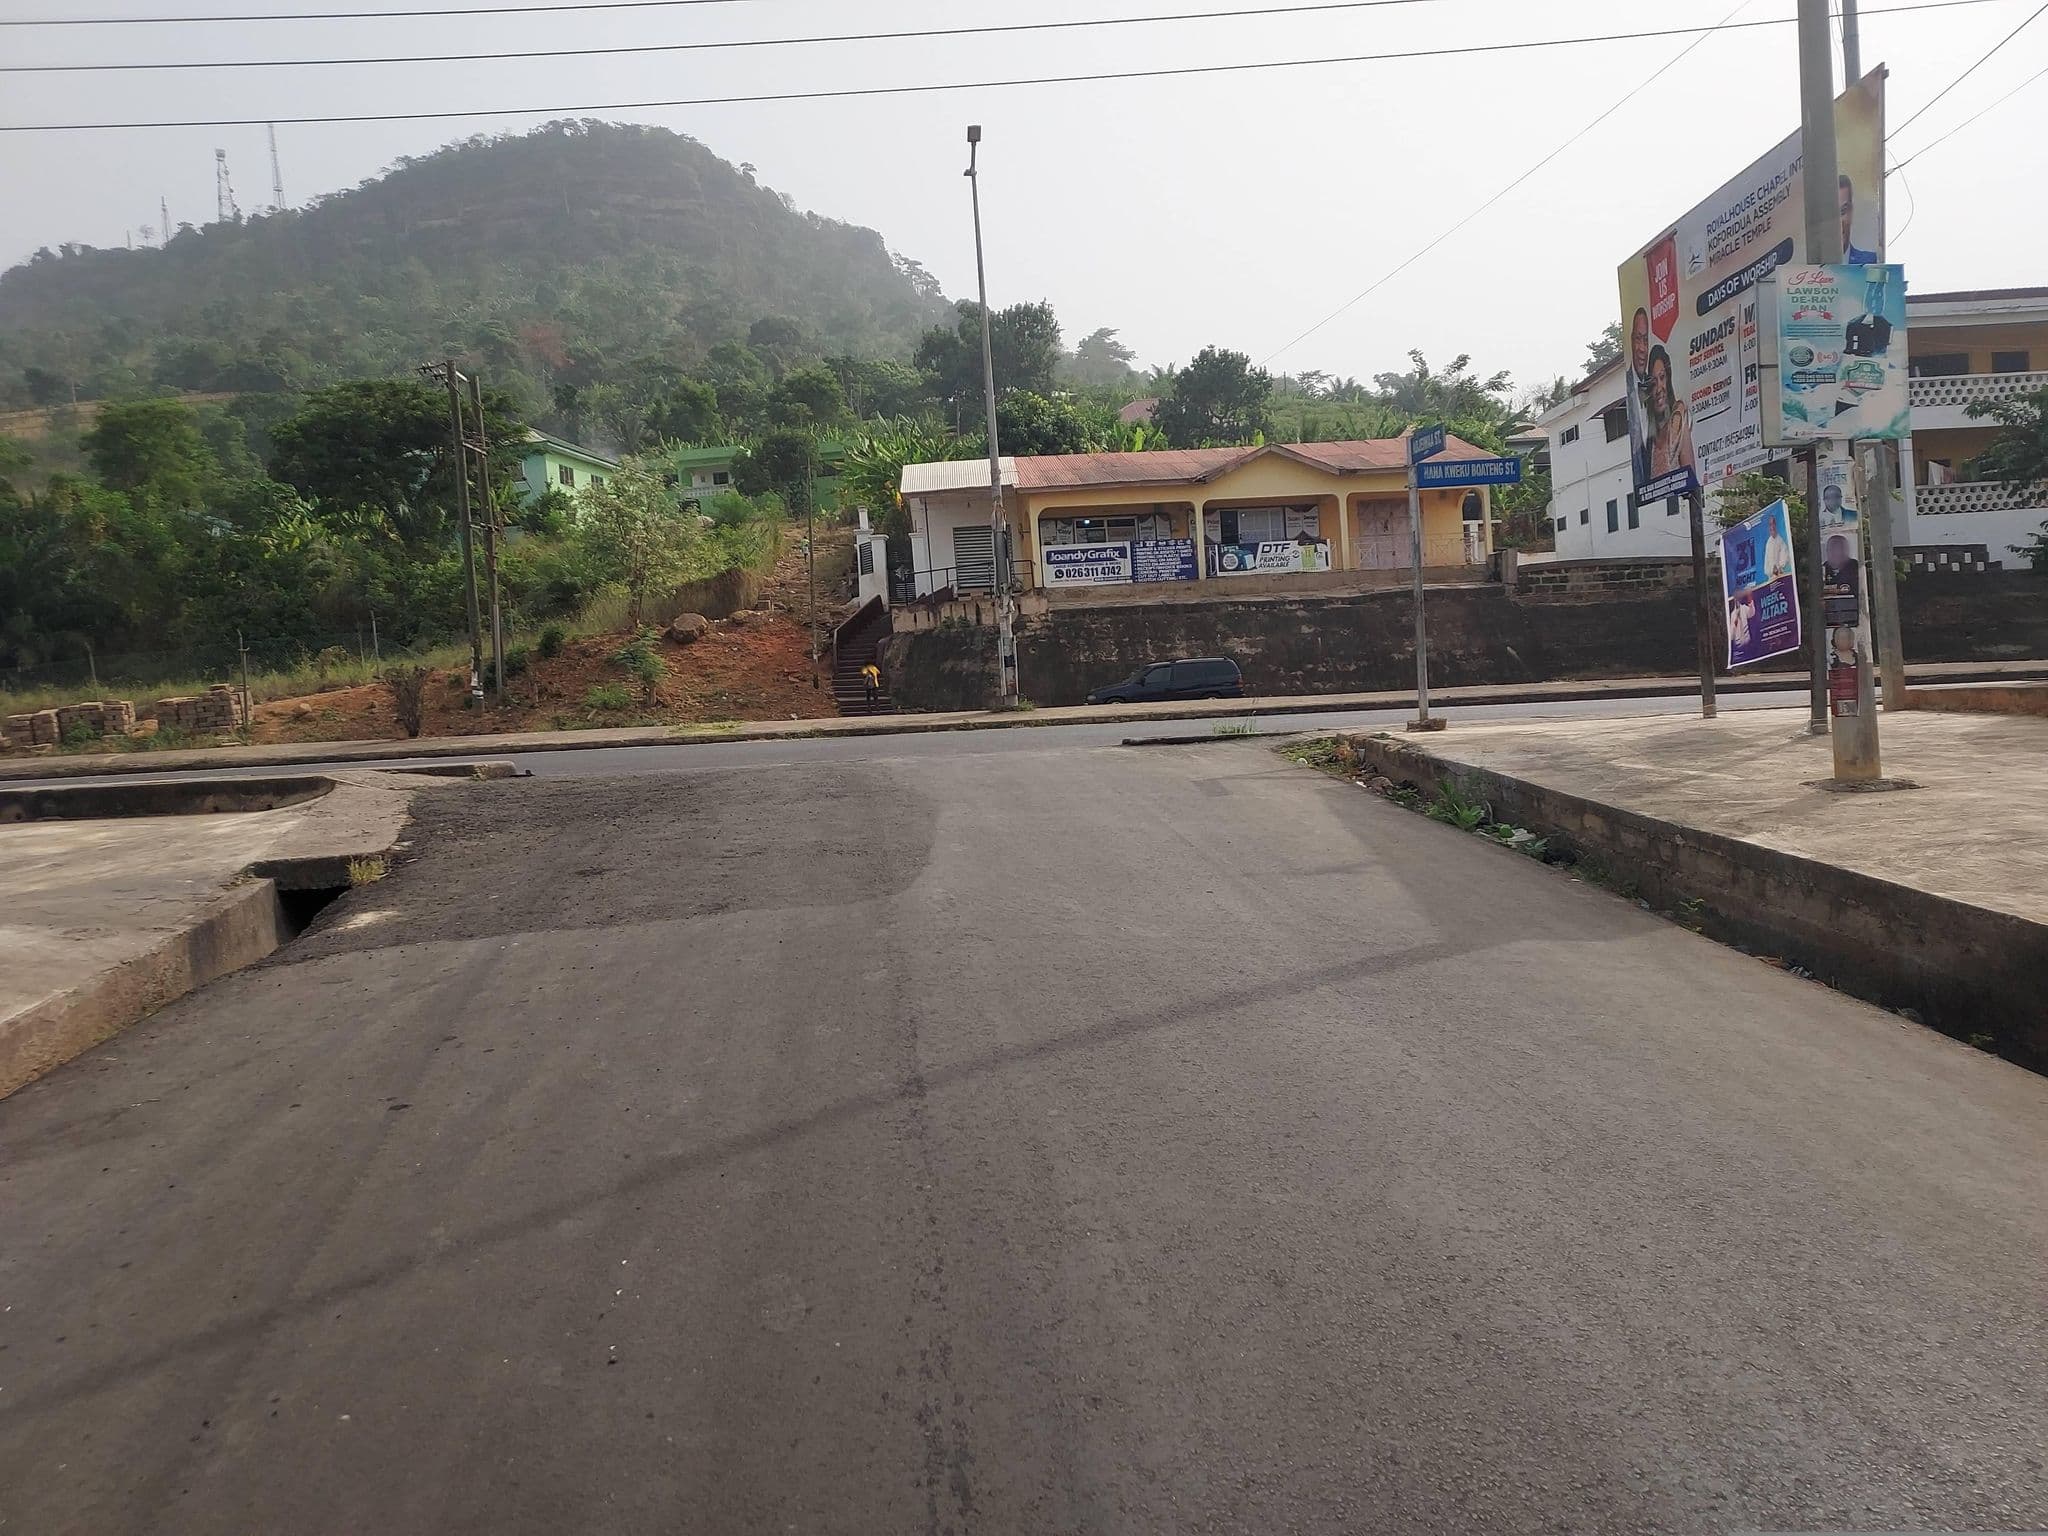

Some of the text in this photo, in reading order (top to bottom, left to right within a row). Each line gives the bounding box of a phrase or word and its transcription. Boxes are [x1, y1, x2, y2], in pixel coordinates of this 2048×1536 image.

[1706, 192, 1756, 236] ROYALHOUSE
[1756, 169, 1788, 200] CHAPEL
[1707, 183, 1791, 252] KOFORIDUA ASSEMBLY
[1708, 216, 1772, 268] MIRACLE TEMPLE
[1655, 257, 1668, 283] JOIN
[1708, 252, 1778, 307] DAYS OF WORSHIP
[1659, 278, 1668, 298] US
[1787, 287, 1839, 295] LAWSON
[1652, 293, 1676, 320] WORSHIP
[1791, 296, 1836, 304] DE-RAY
[1800, 304, 1827, 312] MAN
[1689, 316, 1736, 356] SUNDAYS
[1689, 343, 1725, 368] FIRST SERVICE
[1691, 376, 1732, 402] SECOND SERVICE
[1424, 461, 1516, 480] NANA KWEKU BOATENG ST.
[1261, 543, 1292, 553] DTF
[1259, 555, 1291, 563] PRINTING
[1736, 571, 1757, 586] NIGHT
[1760, 591, 1780, 608] WEEK
[1760, 601, 1788, 622] ALTAR
